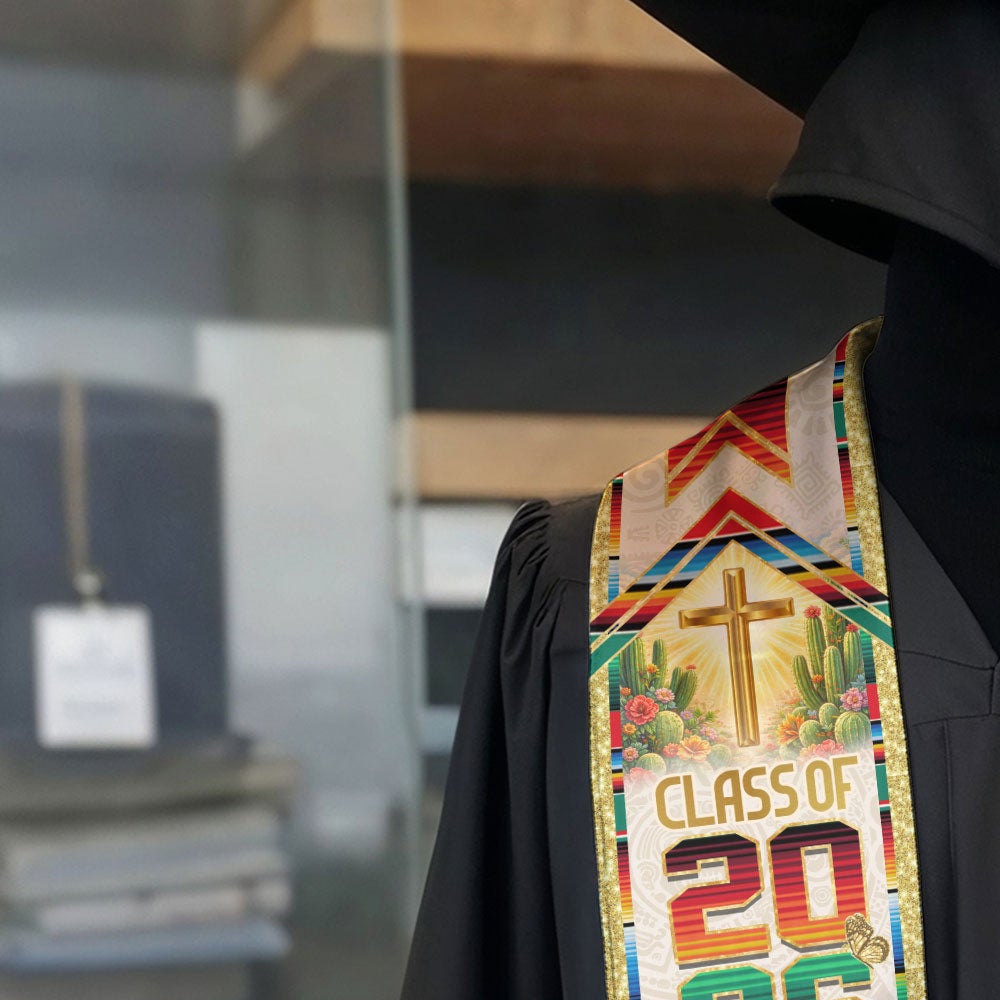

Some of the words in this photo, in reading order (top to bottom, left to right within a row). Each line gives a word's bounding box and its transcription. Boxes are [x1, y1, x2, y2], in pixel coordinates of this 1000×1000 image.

[655, 763, 799, 830] CLASS
[805, 756, 858, 813] OF
[661, 818, 871, 969] 20
